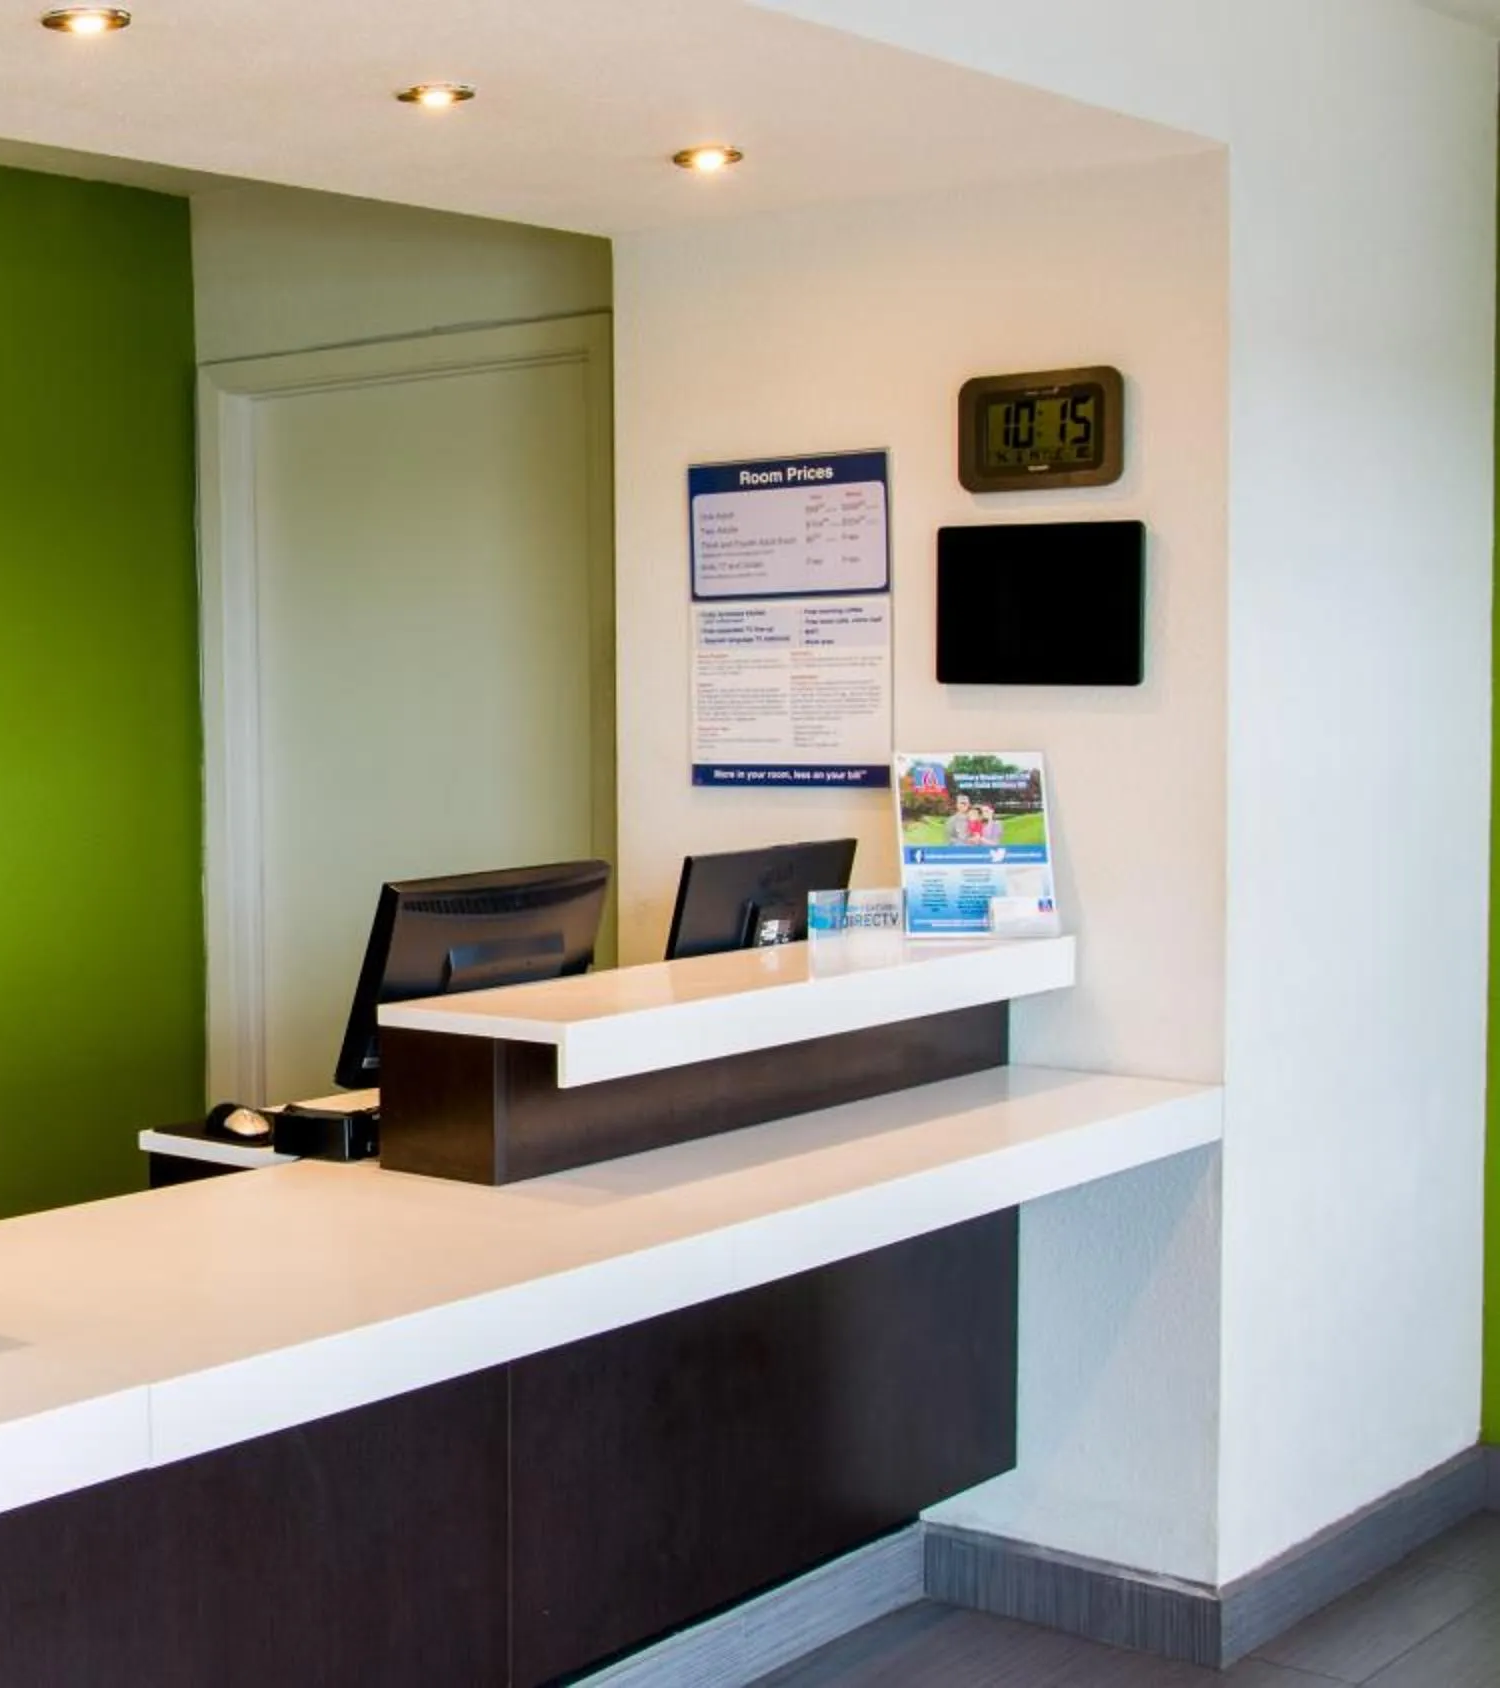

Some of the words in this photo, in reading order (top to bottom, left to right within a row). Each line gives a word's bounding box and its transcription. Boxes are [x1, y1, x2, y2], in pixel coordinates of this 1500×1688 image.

[1004, 396, 1093, 449] 10:15
[739, 471, 783, 485] Room
[787, 466, 834, 481] Prices
[737, 769, 744, 779] in
[747, 771, 766, 781] your
[826, 771, 845, 781] your
